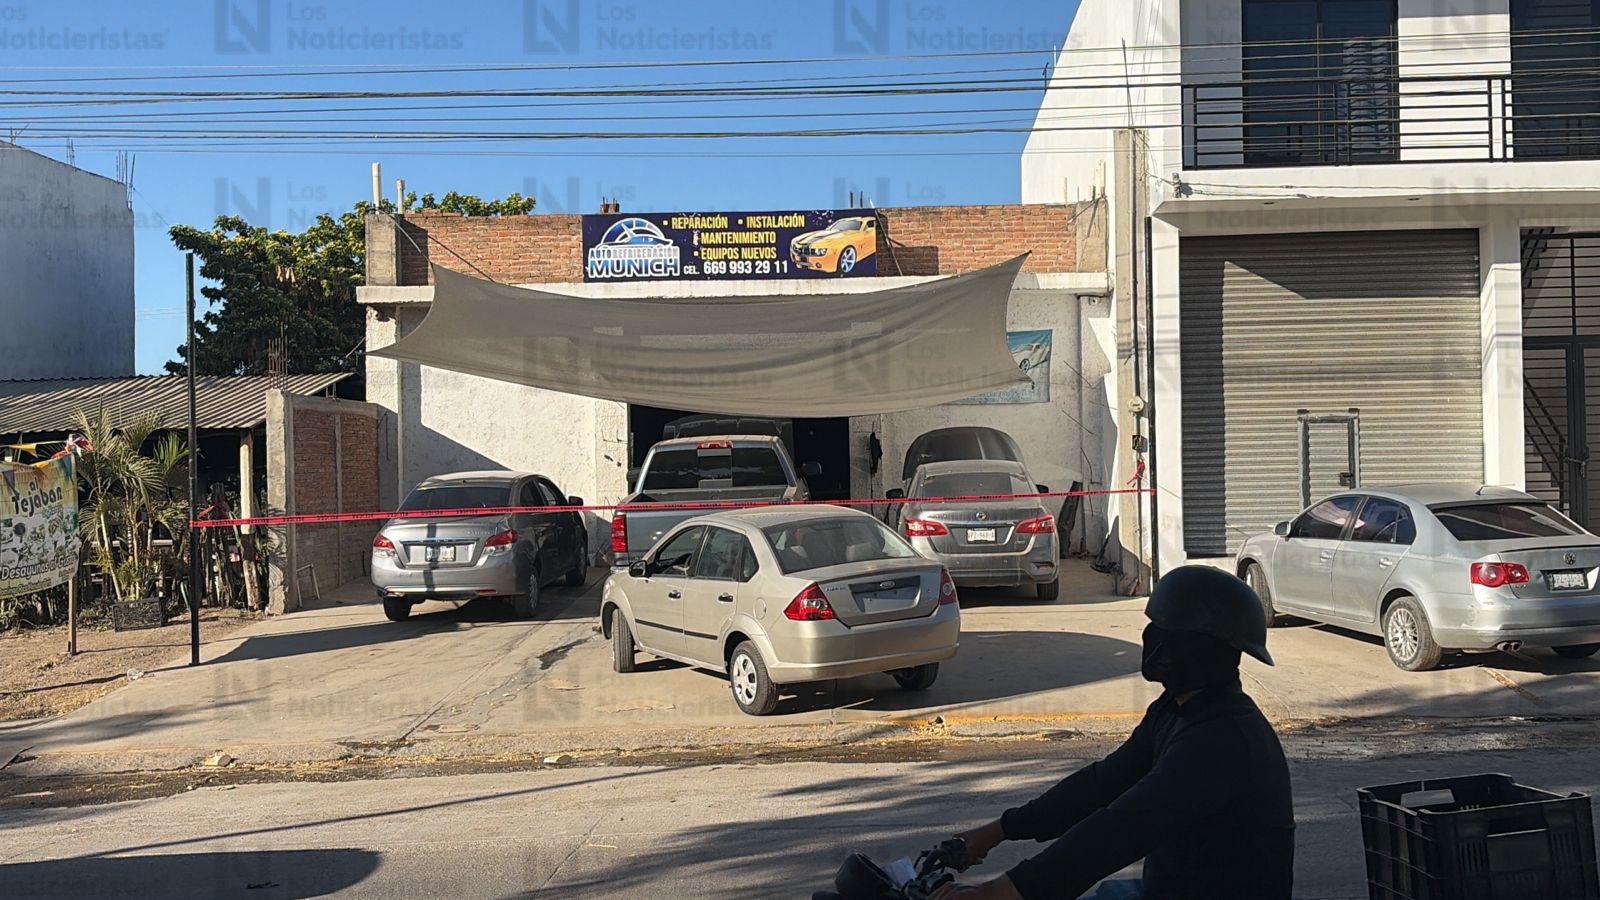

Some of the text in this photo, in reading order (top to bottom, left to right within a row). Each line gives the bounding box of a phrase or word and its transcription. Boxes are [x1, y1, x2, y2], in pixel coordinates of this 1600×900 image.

[671, 213, 805, 229] REPARACIÓN INSTALACIÓN
[701, 231, 776, 245] MANTENIMIENTO
[701, 247, 777, 260] EQUIPOS NUEVOS
[589, 258, 680, 277] MUNICH
[683, 260, 788, 275] CEL. 669 993 29 11
[1, 562, 49, 580] Desayunos
